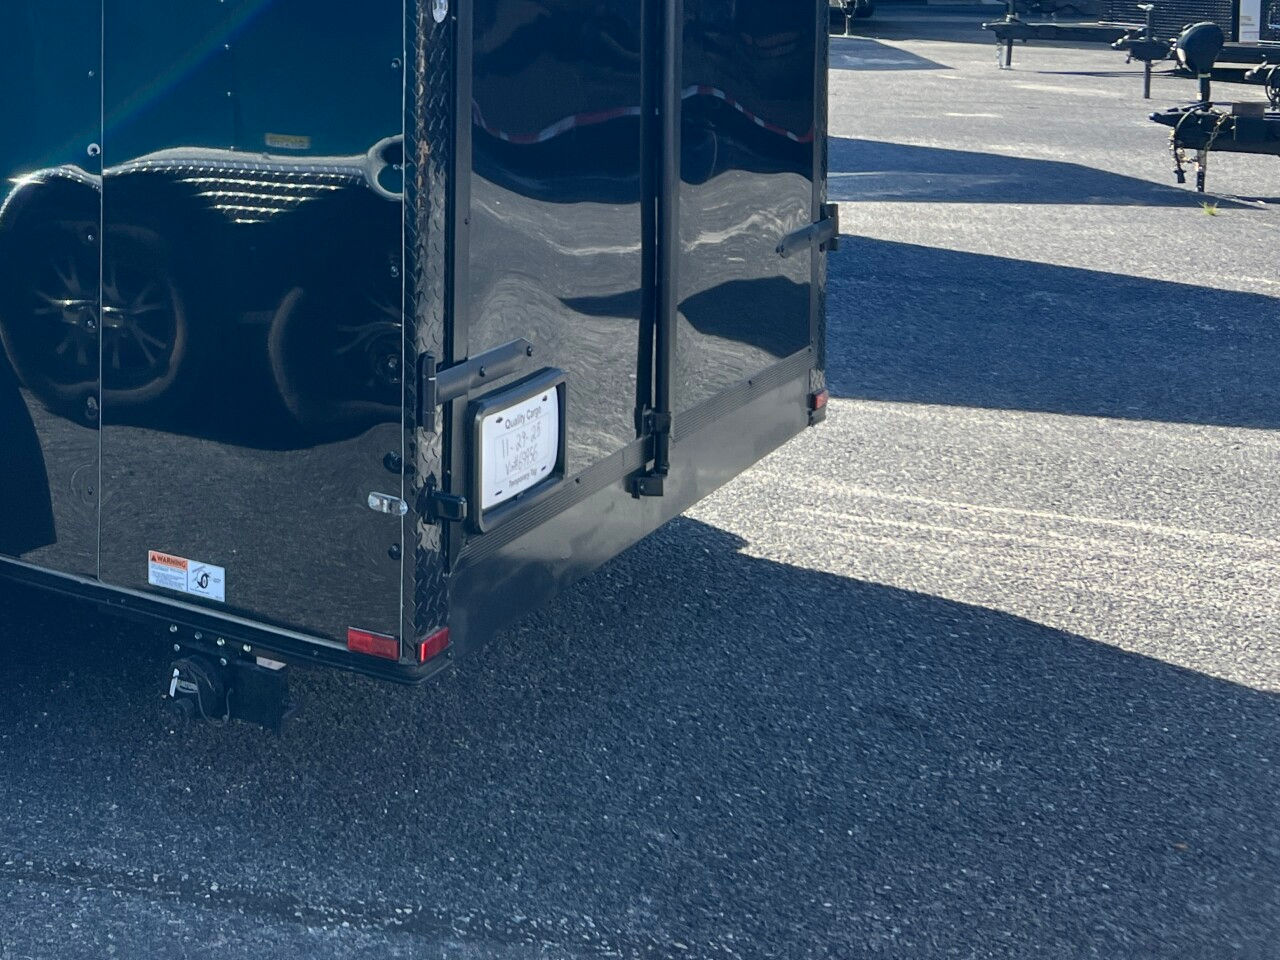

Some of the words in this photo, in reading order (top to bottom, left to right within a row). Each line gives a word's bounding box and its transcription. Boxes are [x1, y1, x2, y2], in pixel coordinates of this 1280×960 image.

[504, 413, 525, 429] Quality
[526, 406, 542, 420] Cargo
[157, 555, 186, 568] WARNING
